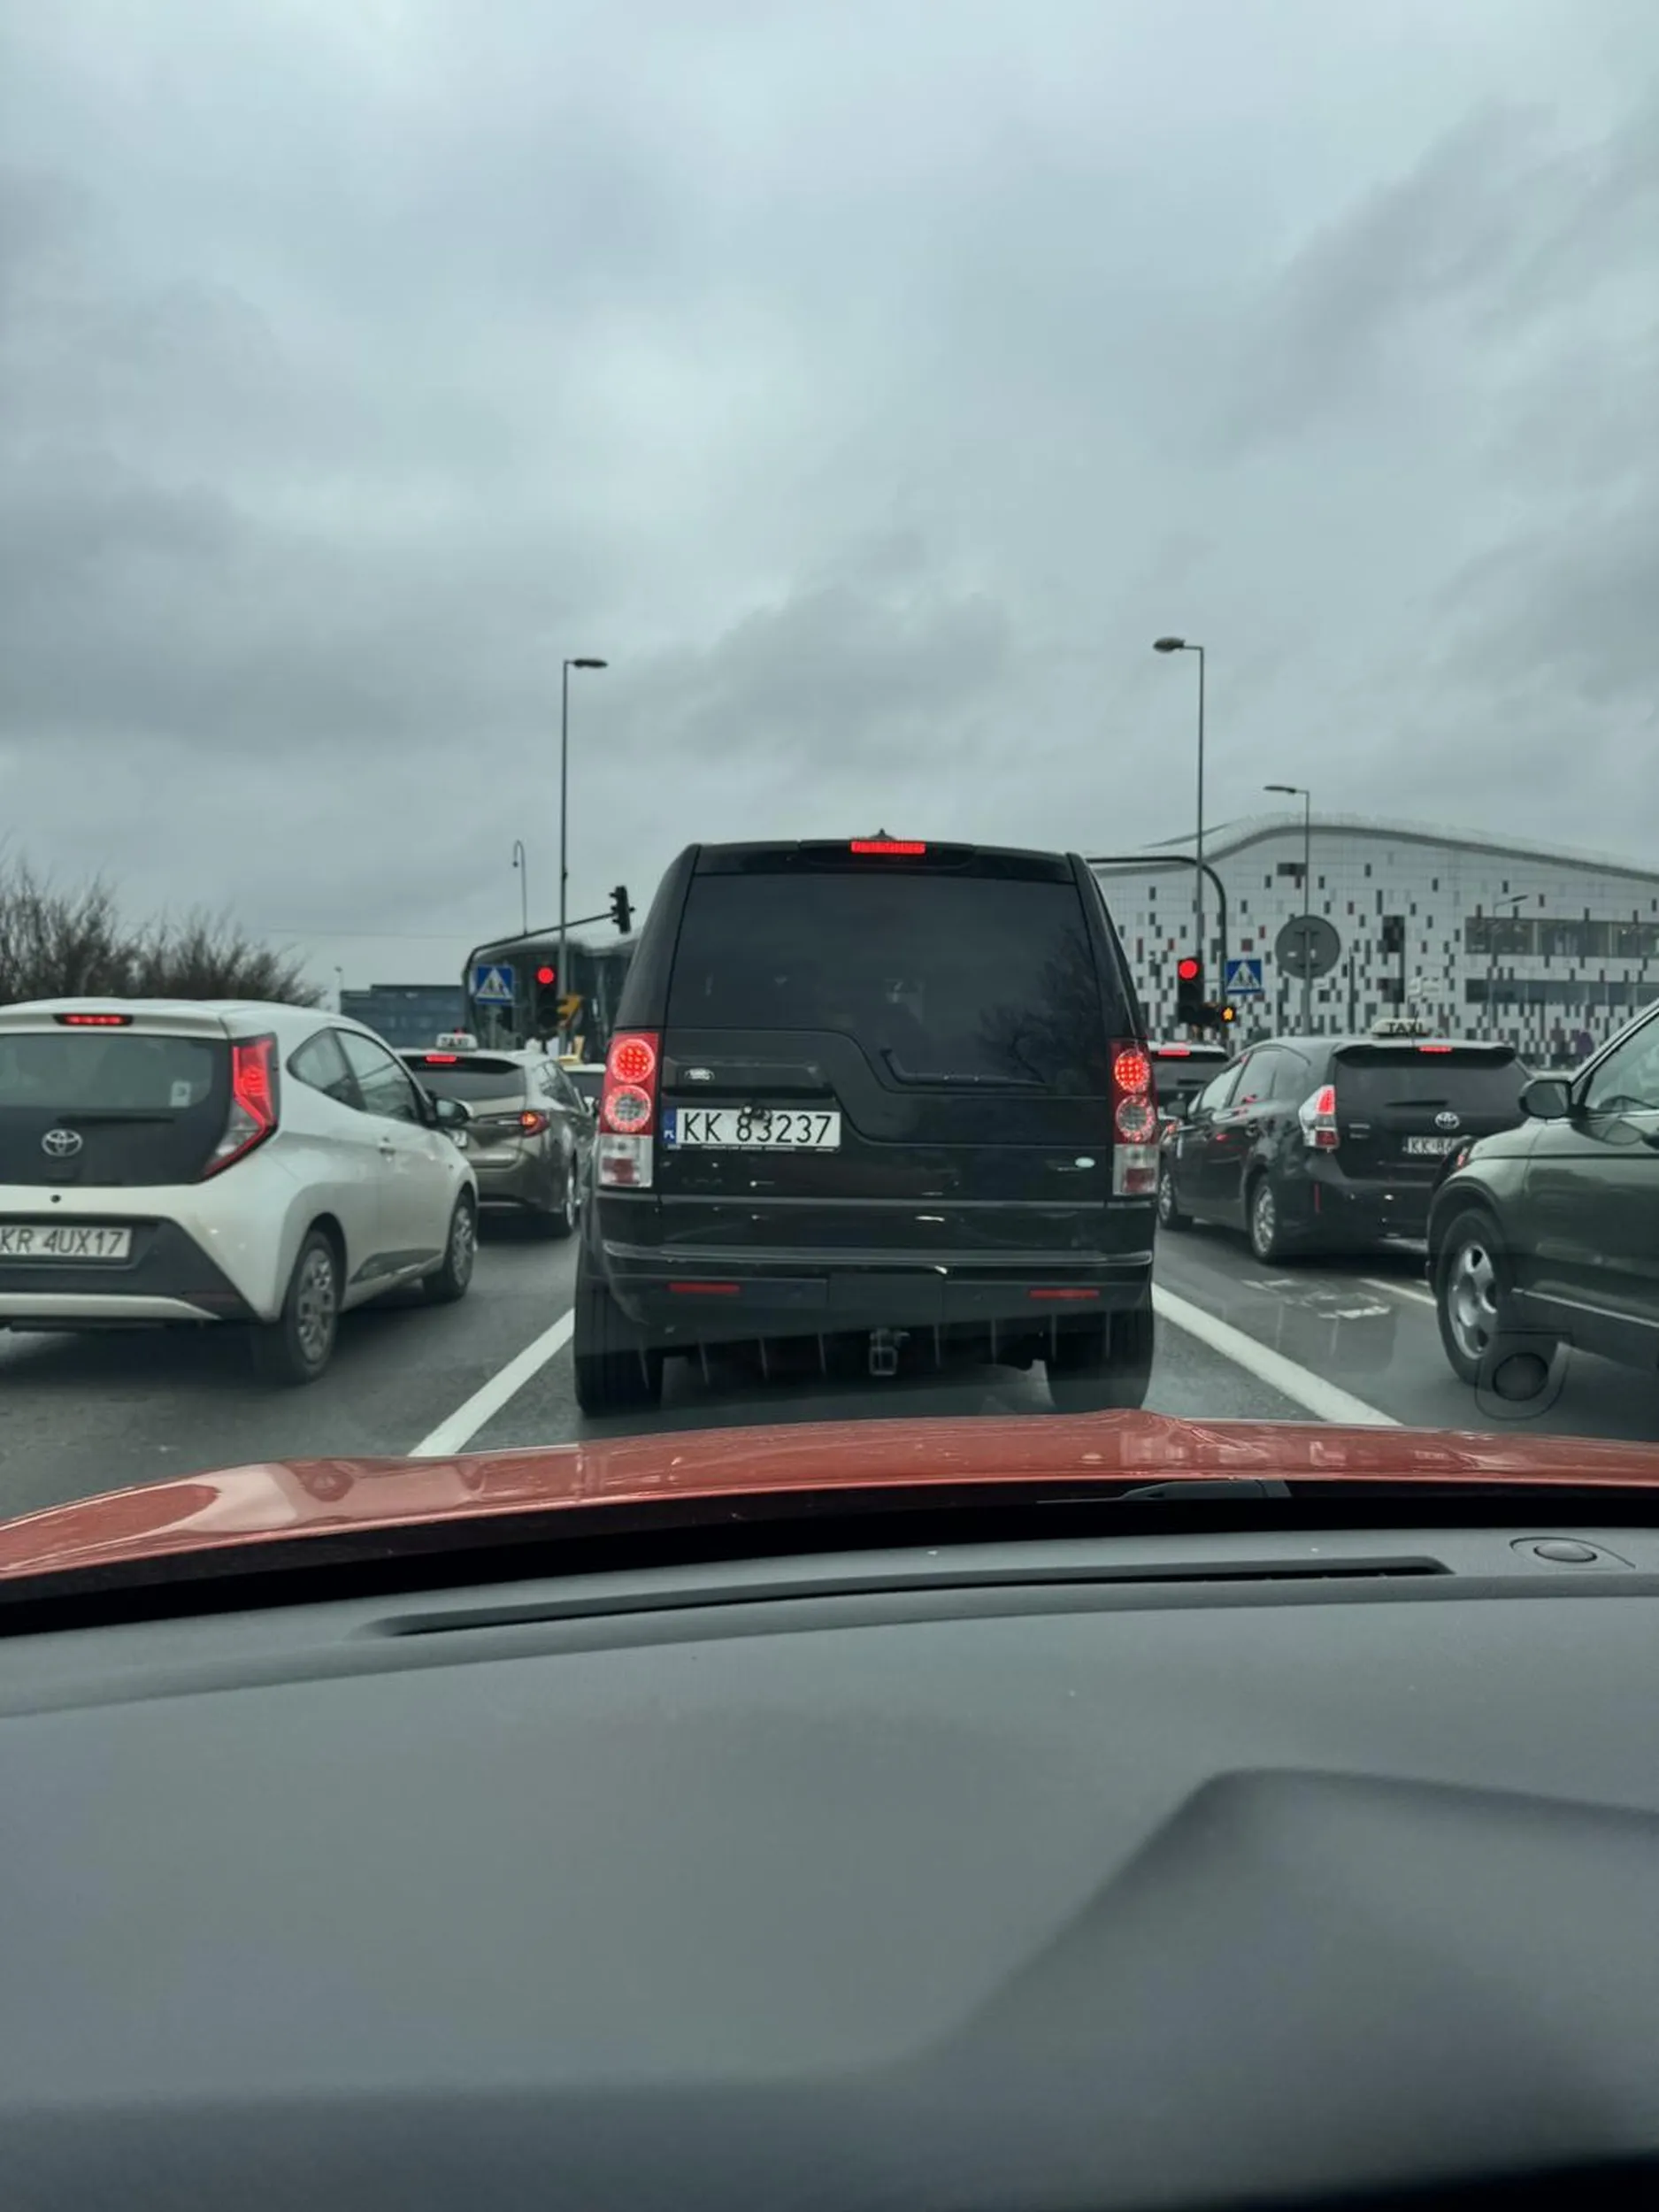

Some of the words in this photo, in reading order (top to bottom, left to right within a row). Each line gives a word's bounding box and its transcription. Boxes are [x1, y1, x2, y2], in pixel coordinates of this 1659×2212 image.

[1385, 1022, 1424, 1033] TAXI
[683, 1112, 722, 1142] KK
[736, 1113, 832, 1144] 83237
[0, 1228, 35, 1255] KR
[42, 1228, 124, 1256] 4UX17
